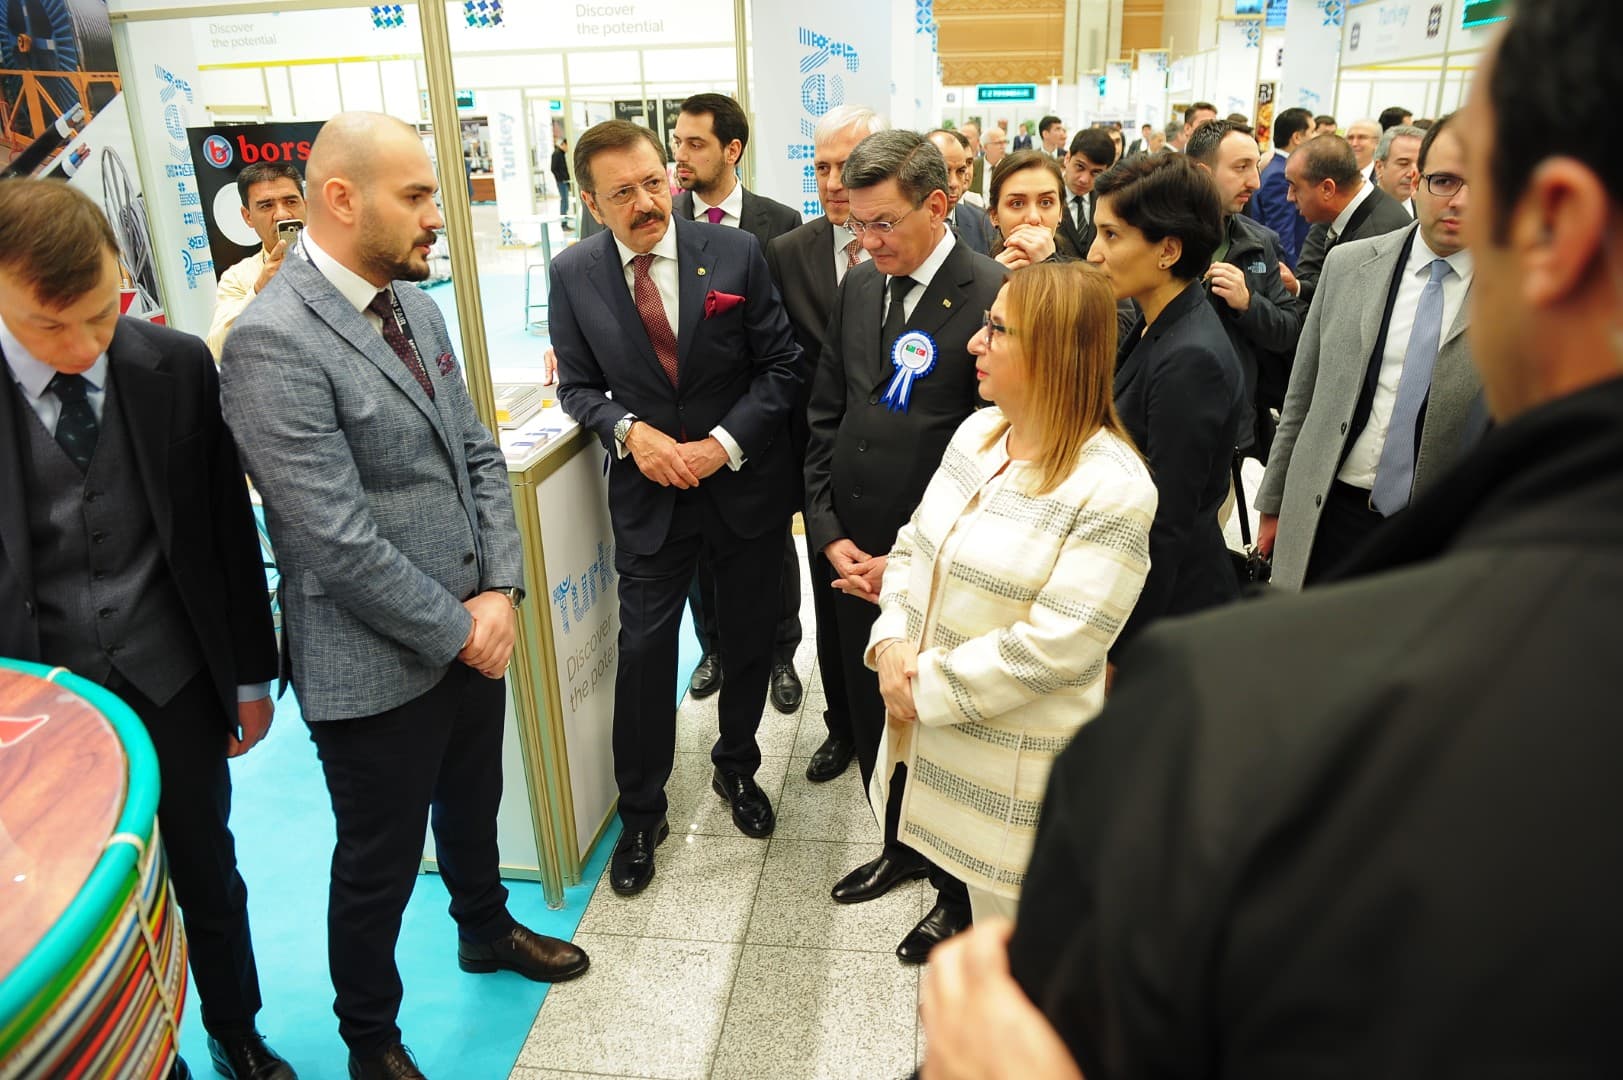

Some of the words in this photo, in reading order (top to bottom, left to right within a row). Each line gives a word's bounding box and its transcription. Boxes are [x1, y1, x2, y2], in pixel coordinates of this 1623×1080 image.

[575, 3, 635, 18] Discover
[209, 23, 255, 34] Discover
[576, 21, 599, 35] the
[602, 18, 664, 37] potential
[211, 37, 230, 48] the
[231, 33, 277, 48] potential
[237, 134, 311, 163] bors
[552, 541, 617, 635] Turk
[566, 612, 613, 682] Discover
[569, 678, 589, 712] the
